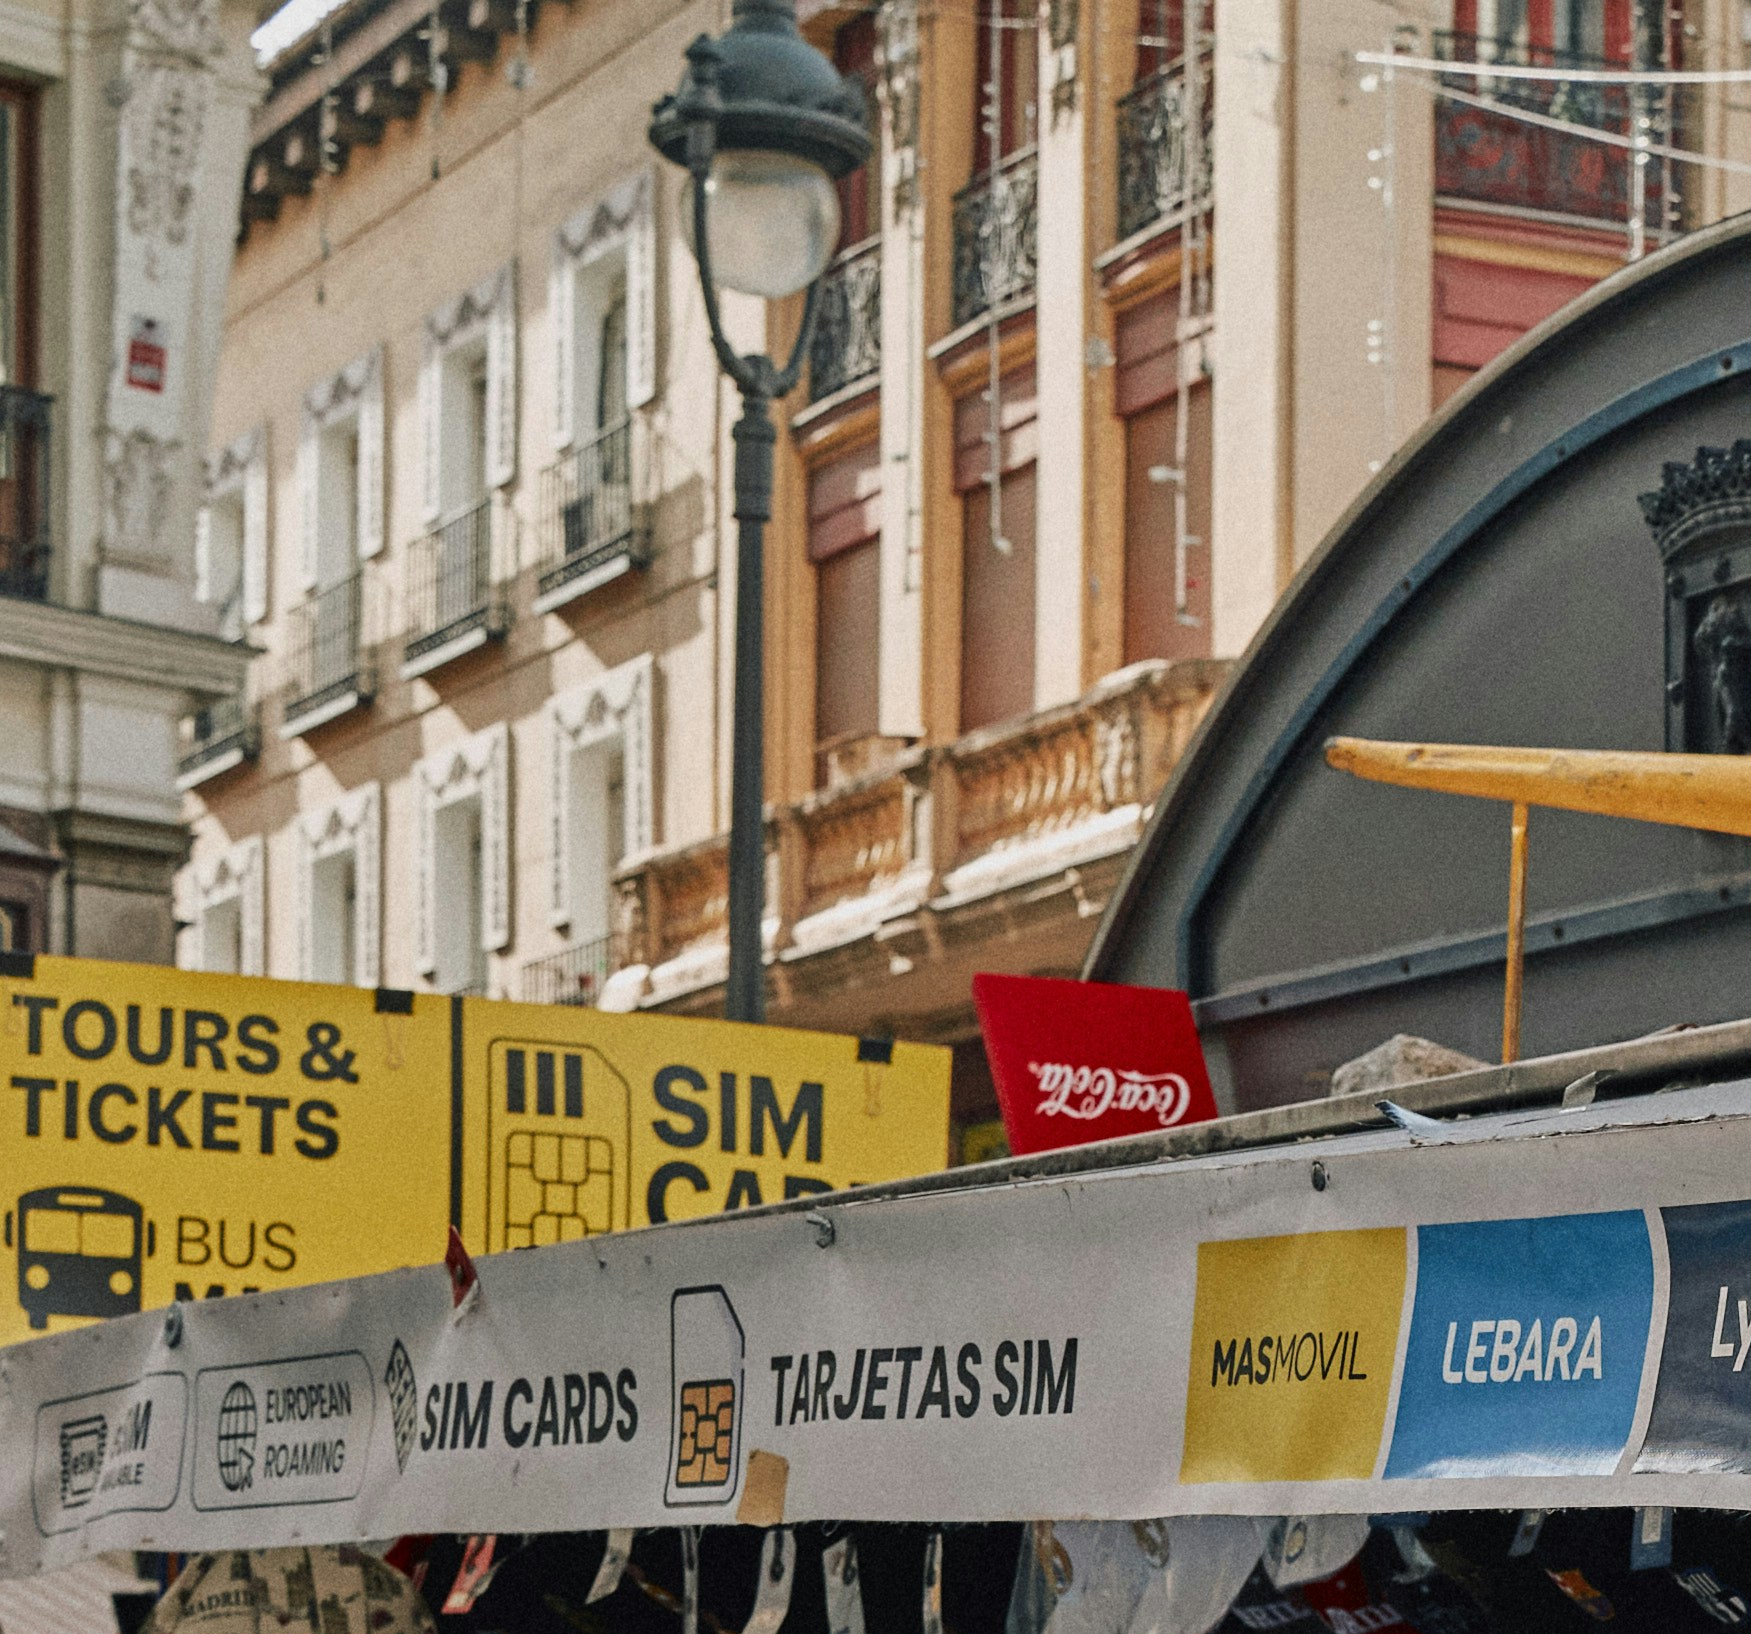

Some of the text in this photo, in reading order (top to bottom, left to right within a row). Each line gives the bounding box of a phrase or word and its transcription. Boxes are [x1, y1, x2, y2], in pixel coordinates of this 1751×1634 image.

[12, 995, 359, 1084] TOURS &
[10, 1076, 340, 1160] TICKETS
[652, 1066, 825, 1163] SIM
[178, 1216, 297, 1272] BUS
[770, 1337, 1079, 1426] TARJETAS SIM
[1212, 1330, 1368, 1389] MASMOVIL
[1442, 1315, 1603, 1385] LEBARA
[265, 1381, 352, 1424] EUROPEAN
[420, 1382, 499, 1450] SIM
[502, 1368, 641, 1449] CARDS
[264, 1439, 346, 1479] ROAMING
